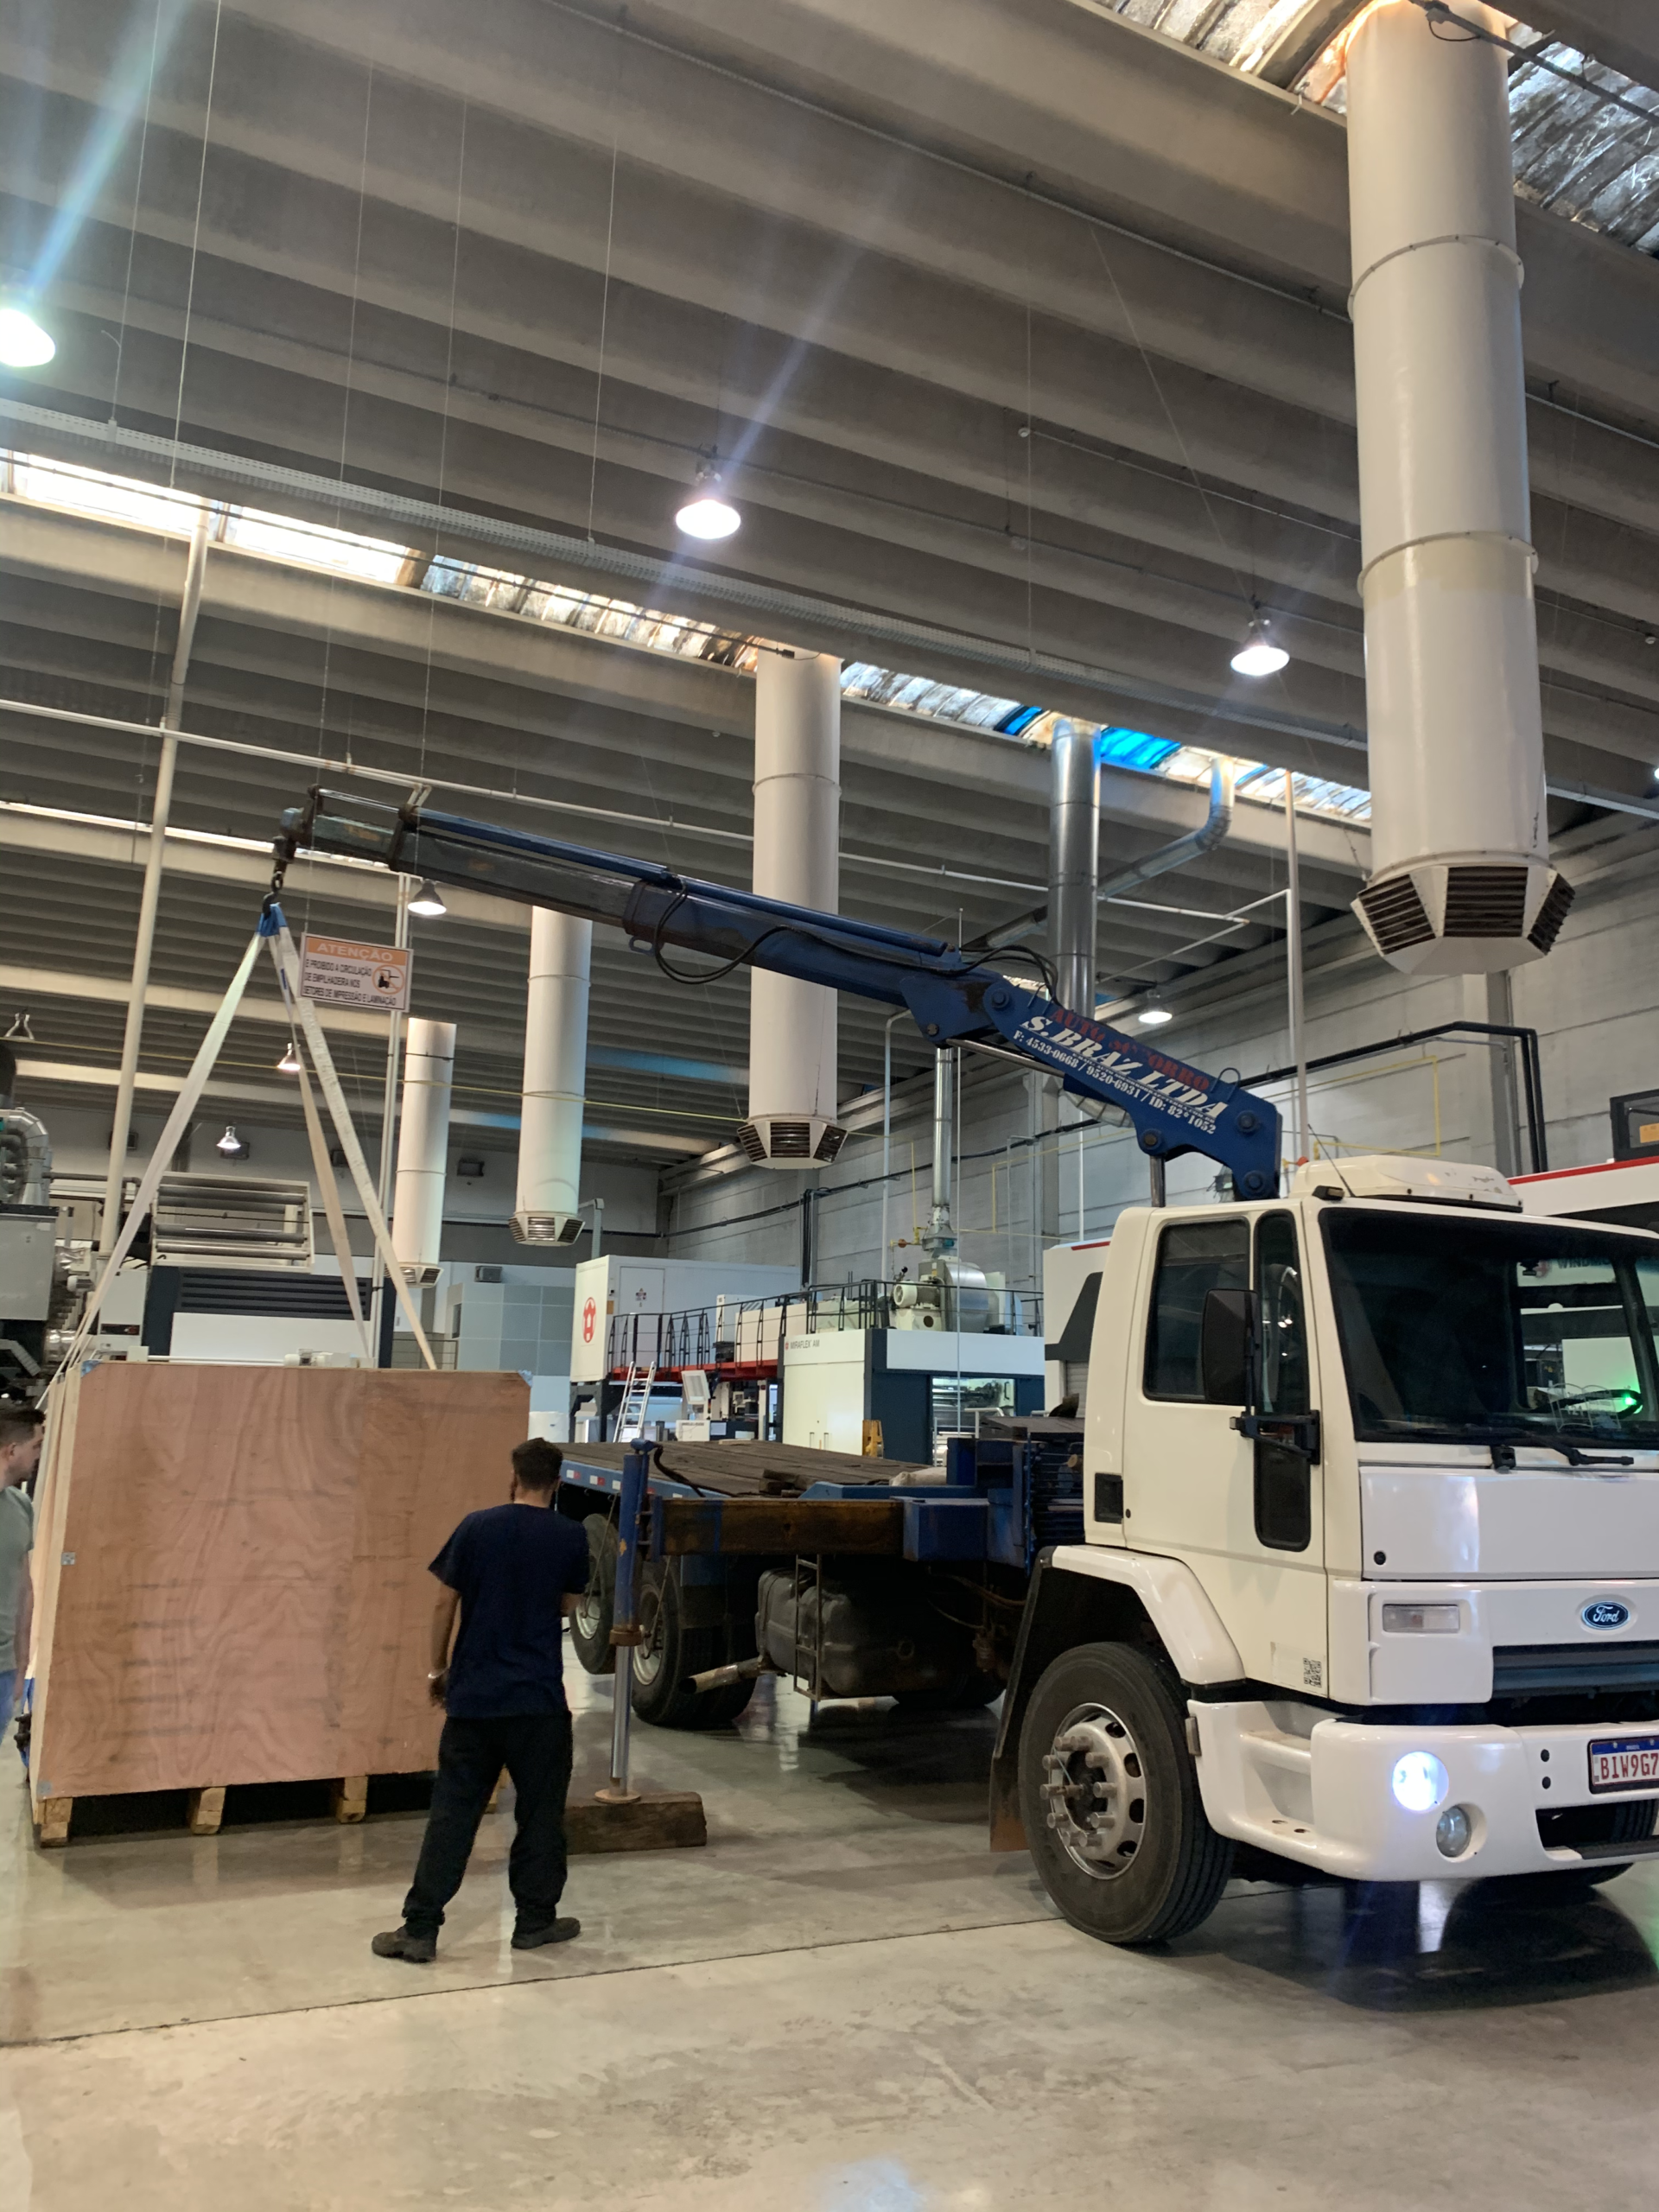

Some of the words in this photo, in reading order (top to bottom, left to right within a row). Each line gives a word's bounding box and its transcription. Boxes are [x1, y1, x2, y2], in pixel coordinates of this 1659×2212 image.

[317, 943, 393, 962] ATENÇÃO
[310, 960, 334, 971] PROIBIDO
[340, 963, 372, 977] CIRCULAÇÃO
[304, 972, 312, 982] DE
[312, 974, 349, 986] EMPILHADEIRA
[350, 979, 360, 988] NOS
[303, 985, 324, 996] SETORES
[325, 988, 333, 997] DE
[334, 989, 361, 1001] IMPRESSÃO
[367, 995, 396, 1006] LAMINAÇÃO
[1026, 1037, 1080, 1068] 4533-0668
[1085, 1065, 1141, 1098] 9520-6931
[1148, 1093, 1166, 1111] ID:
[1136, 1070, 1229, 1119] LTDA
[791, 1340, 810, 1349] MIRAFLEX
[1592, 1605, 1620, 1623] Ford
[1600, 1752, 1659, 1780] BIW9G7
